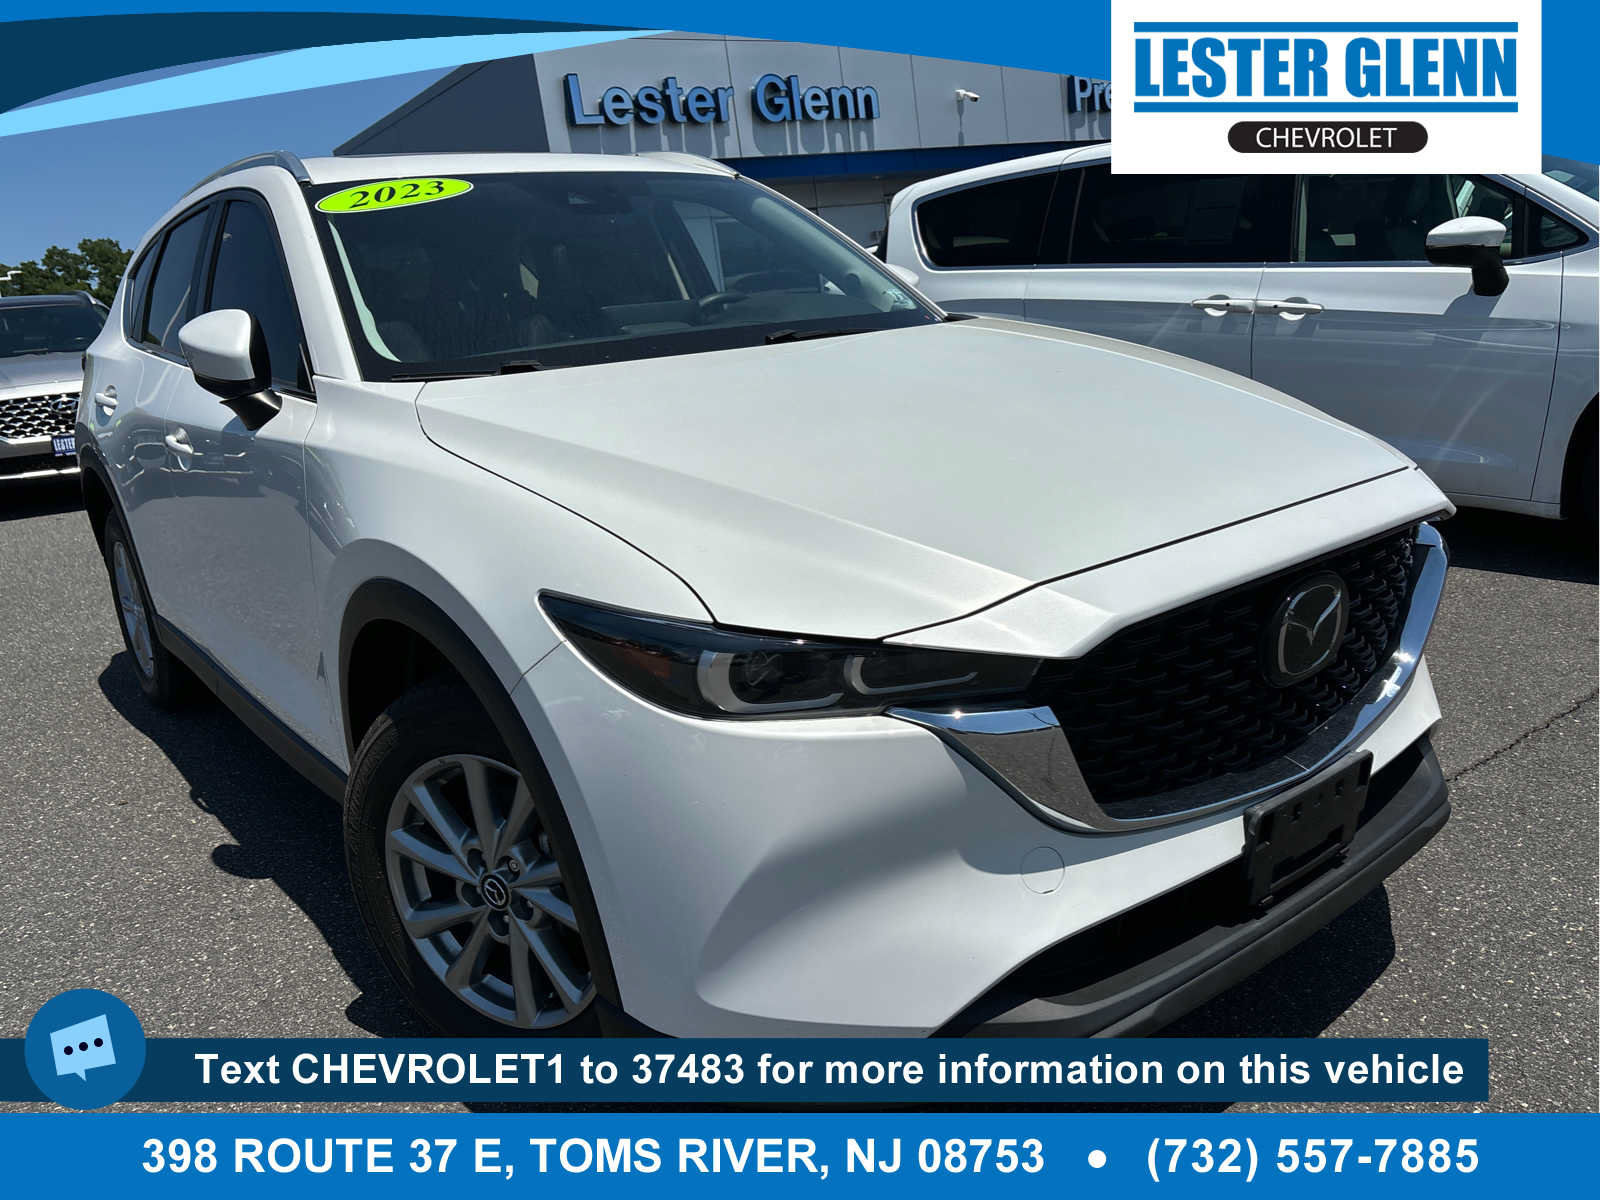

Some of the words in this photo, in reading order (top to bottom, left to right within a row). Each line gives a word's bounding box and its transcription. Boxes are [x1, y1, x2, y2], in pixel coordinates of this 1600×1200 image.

[564, 73, 734, 125] Lester
[753, 73, 881, 122] Glenn
[350, 180, 445, 208] 2023
